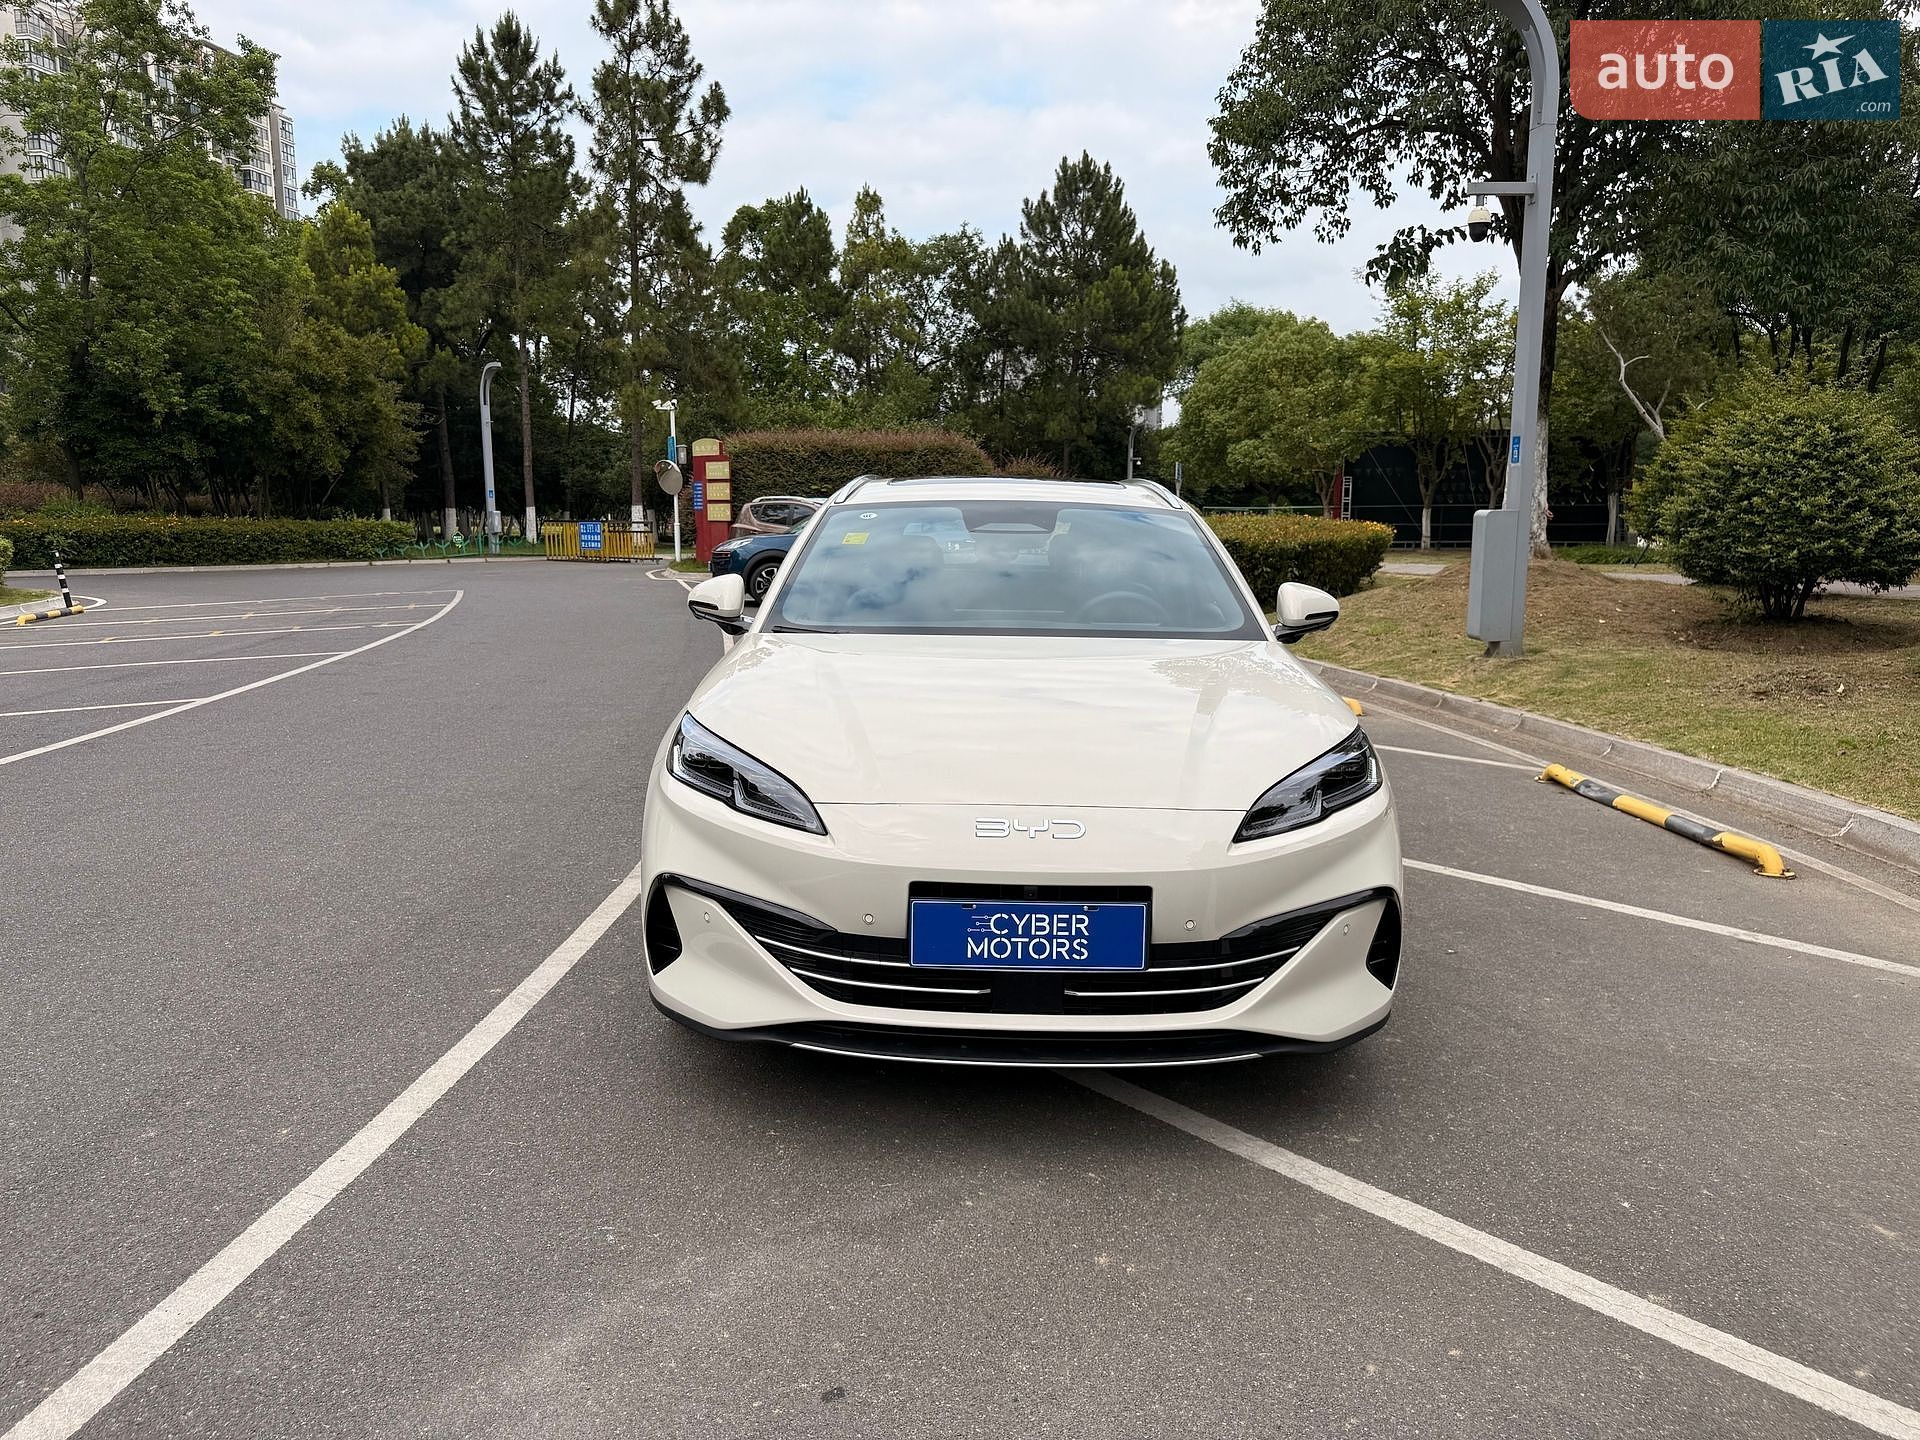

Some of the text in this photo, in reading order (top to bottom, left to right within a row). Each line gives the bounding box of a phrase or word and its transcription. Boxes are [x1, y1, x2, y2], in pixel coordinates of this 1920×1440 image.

[975, 816, 1086, 840] BYD
[989, 913, 1090, 936] CYBER
[967, 936, 1089, 960] MOTORS
